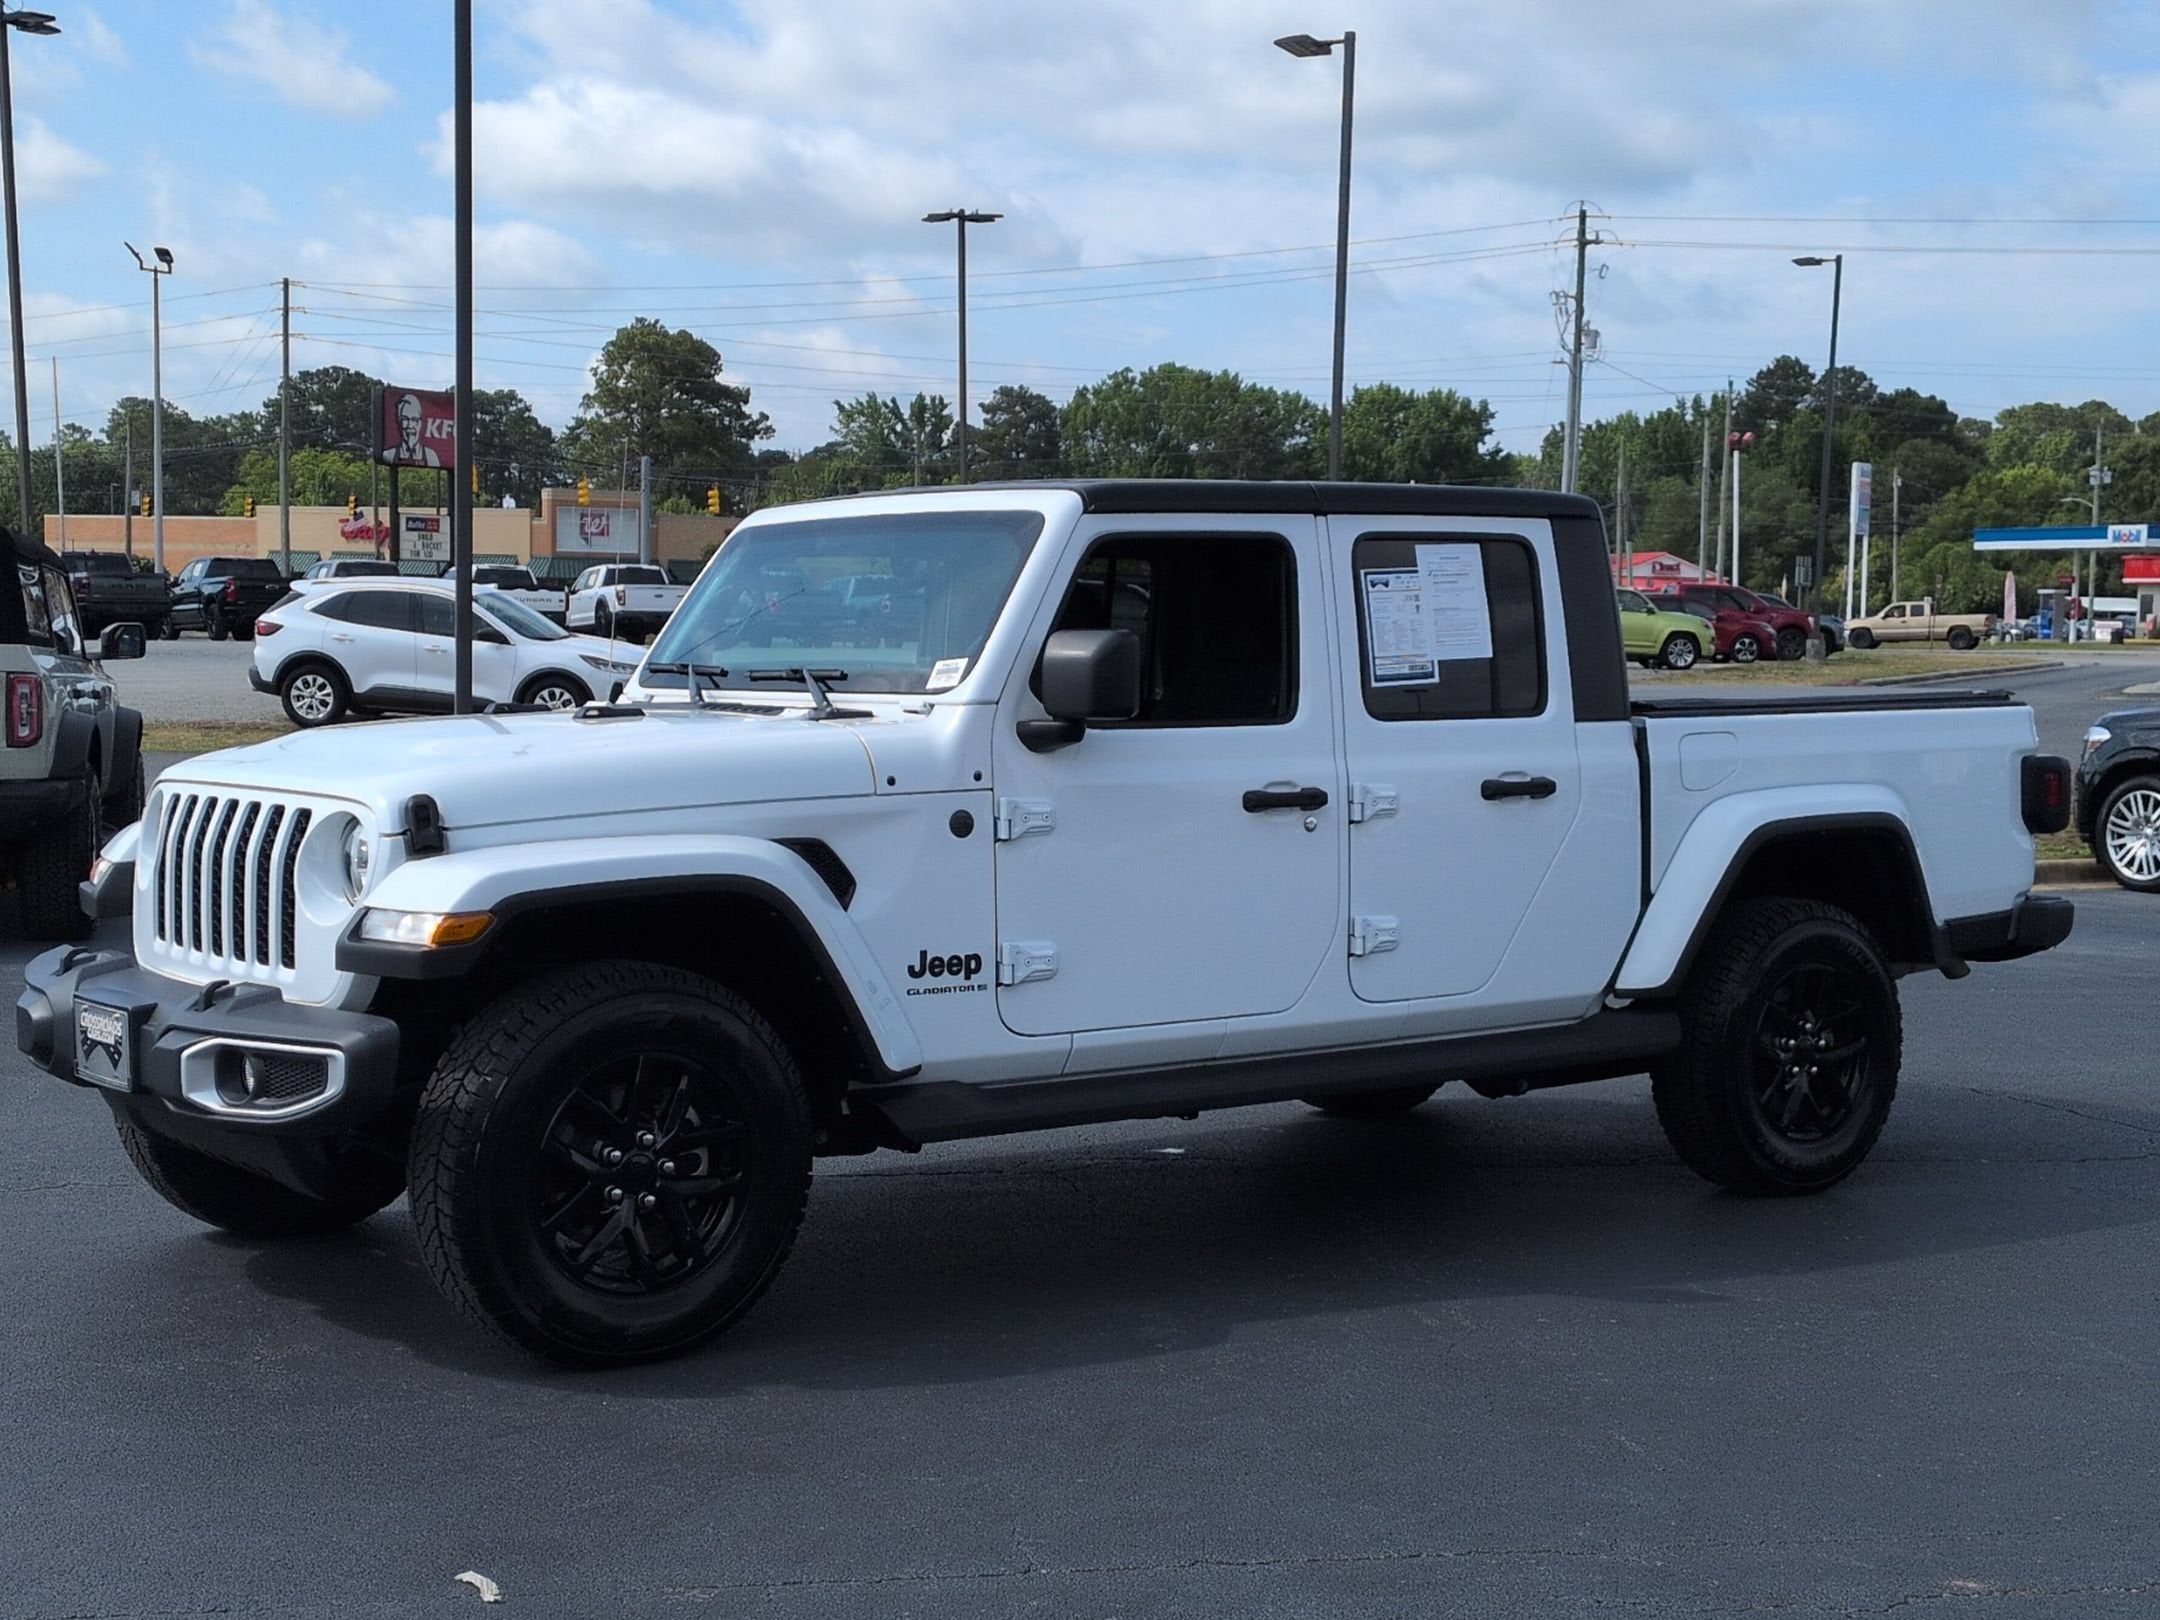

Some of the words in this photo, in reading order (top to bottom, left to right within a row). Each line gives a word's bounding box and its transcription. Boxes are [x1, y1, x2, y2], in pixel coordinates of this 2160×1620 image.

[425, 417, 457, 439] KF
[2112, 528, 2142, 543] Mobil
[907, 949, 983, 980] Jeep
[906, 985, 976, 996] GLADIATOR
[80, 1011, 123, 1037] CROSSROADS
